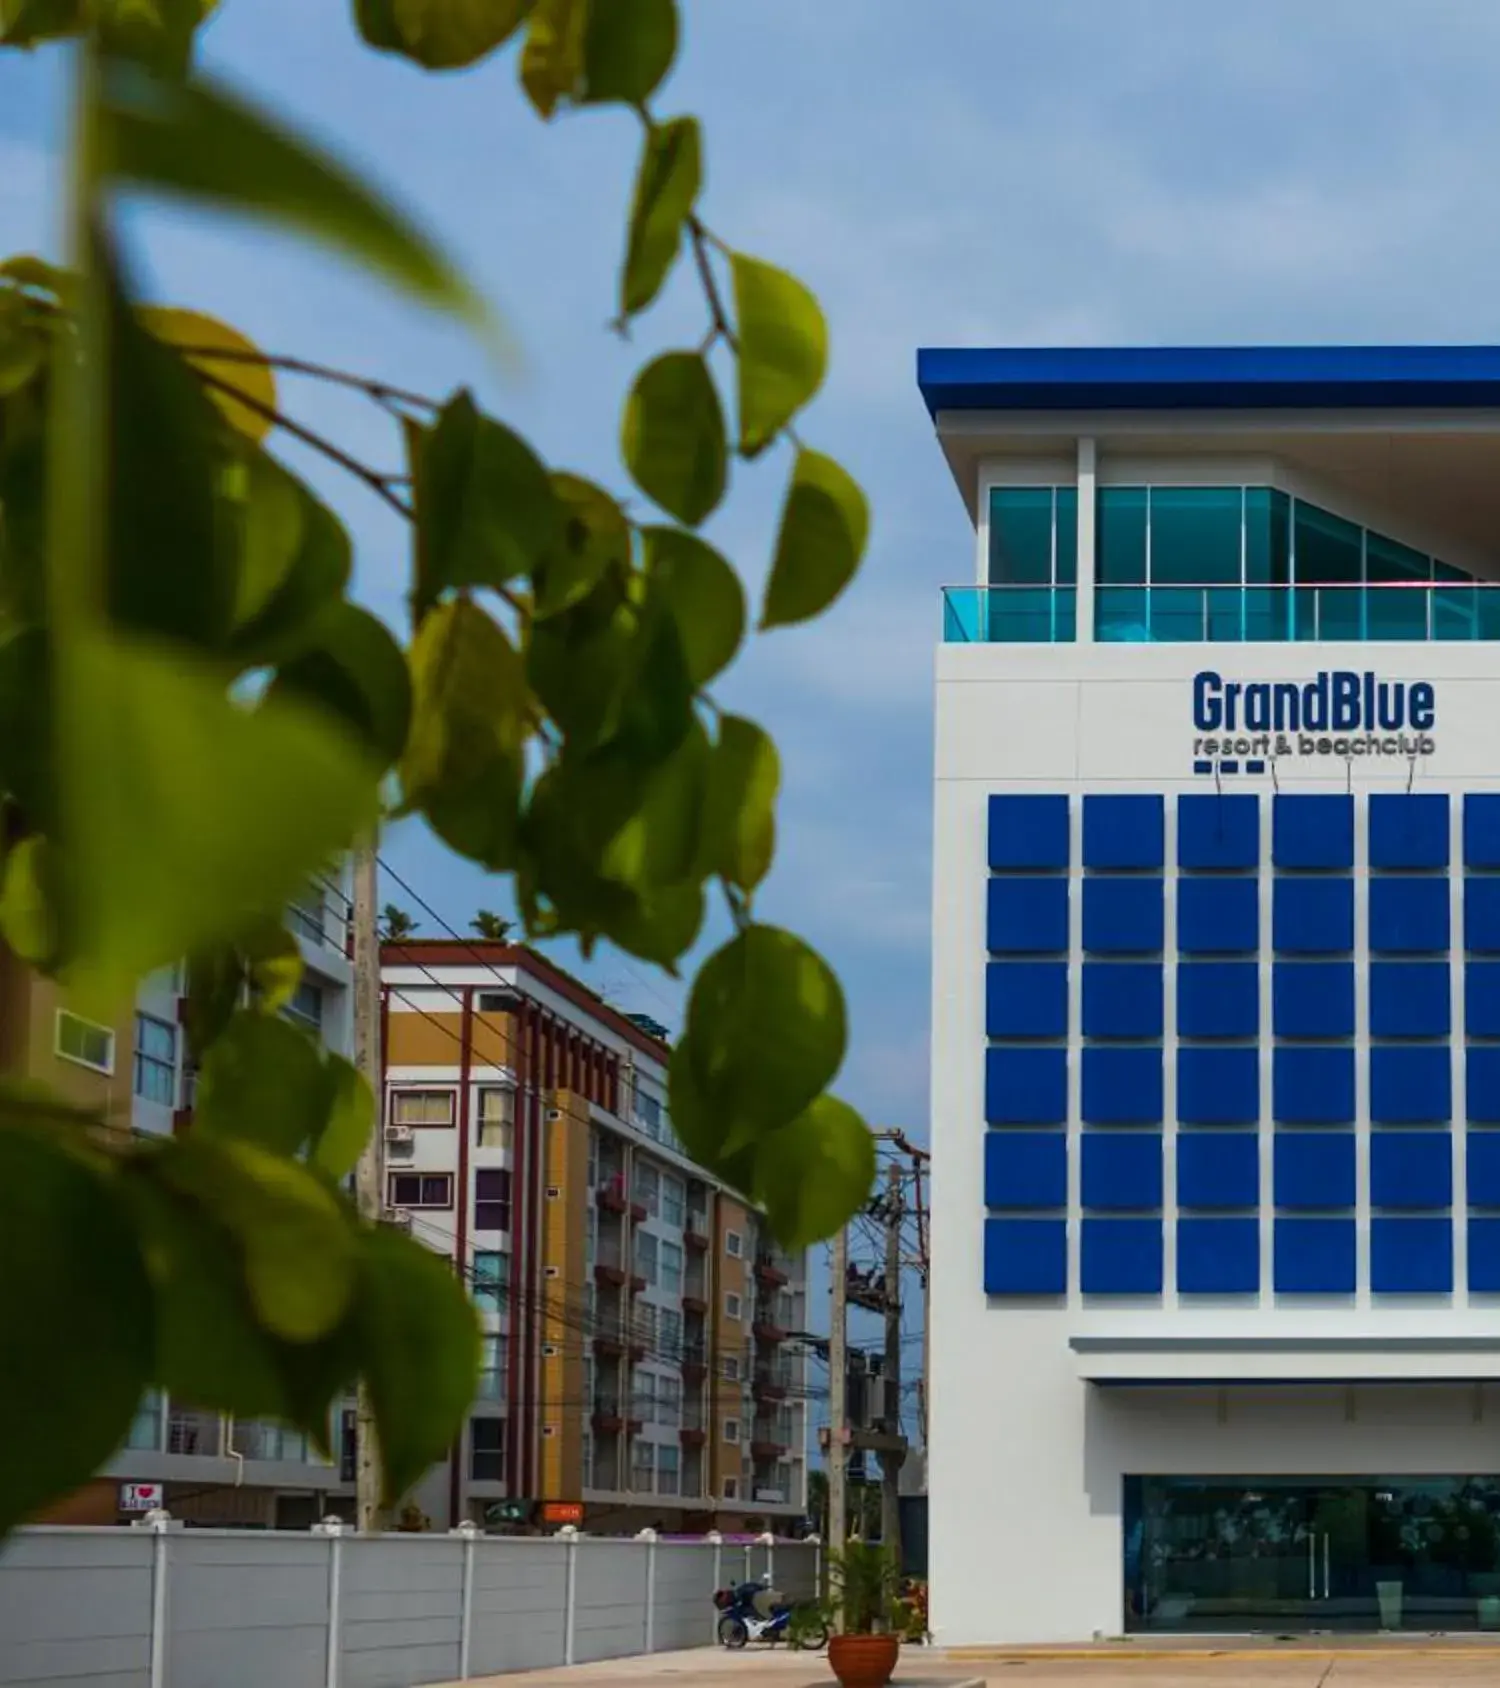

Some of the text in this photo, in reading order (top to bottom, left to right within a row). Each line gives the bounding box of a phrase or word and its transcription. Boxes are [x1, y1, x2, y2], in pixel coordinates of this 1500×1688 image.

[1193, 671, 1435, 731] GrandBlue
[1194, 733, 1435, 755] resort & beachclub
